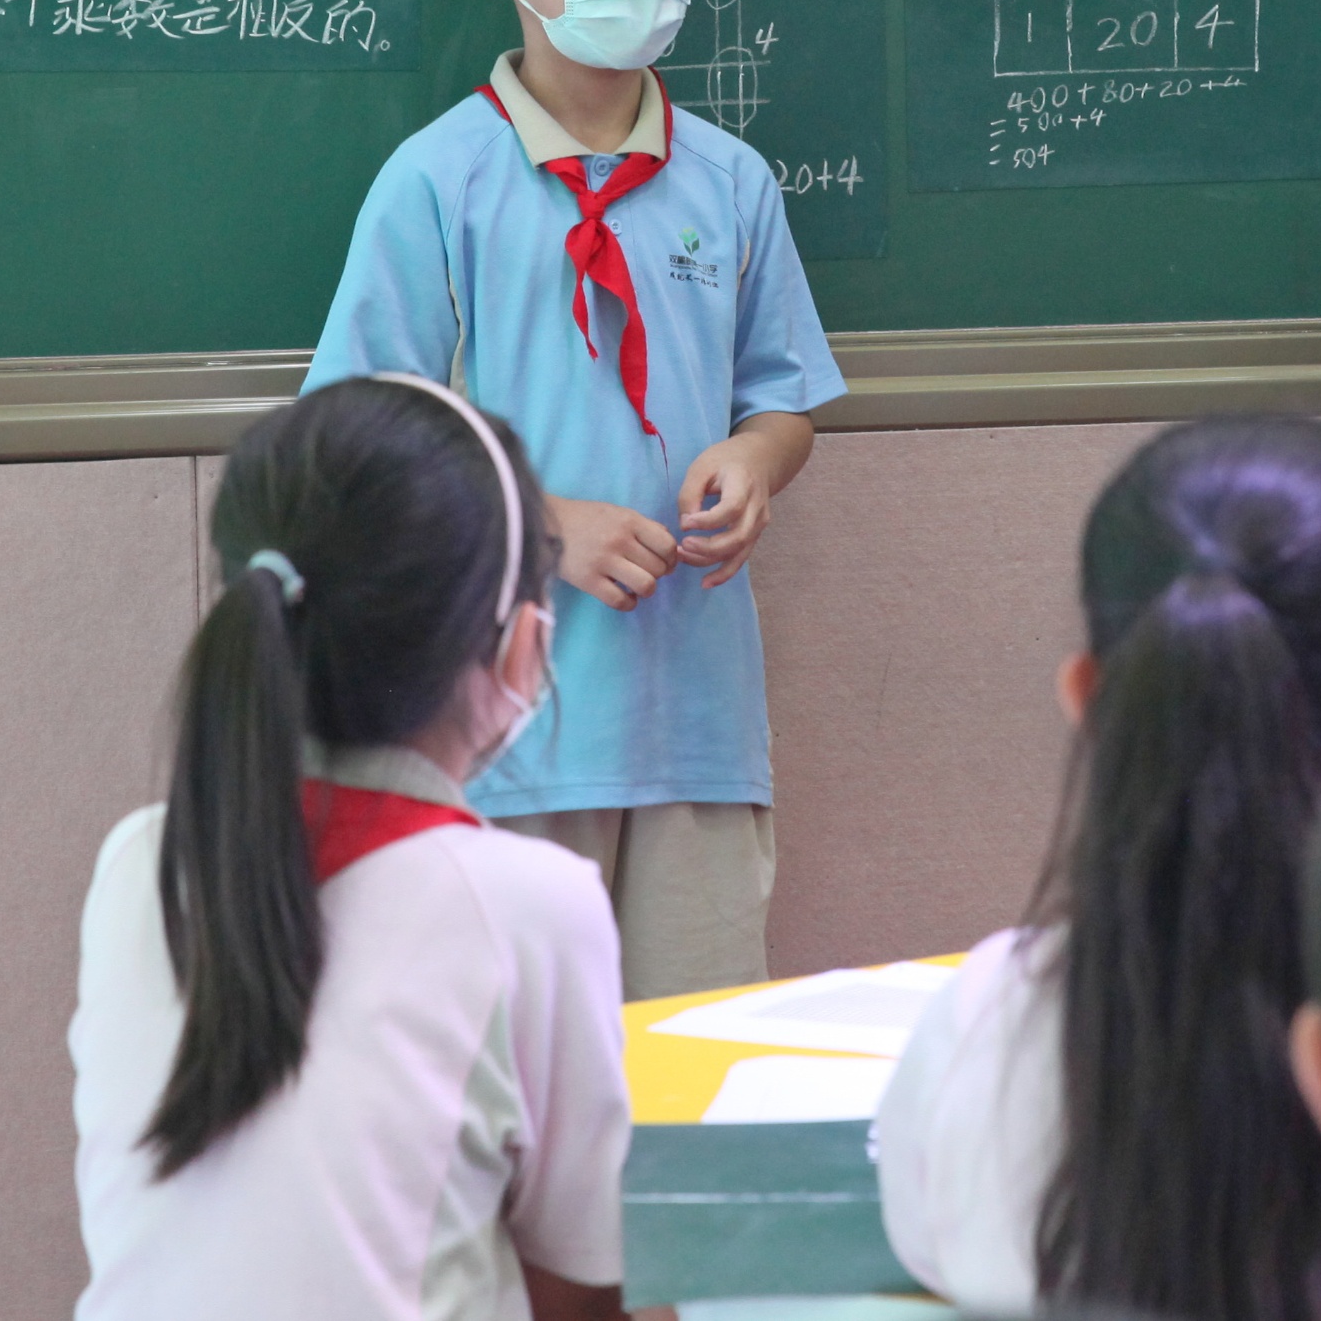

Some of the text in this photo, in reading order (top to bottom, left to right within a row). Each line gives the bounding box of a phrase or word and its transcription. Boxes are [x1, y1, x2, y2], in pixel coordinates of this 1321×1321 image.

[755, 22, 779, 55] 4
[1097, 11, 1158, 51] 20
[1195, 4, 1235, 48] 4
[771, 155, 865, 196] 20+4
